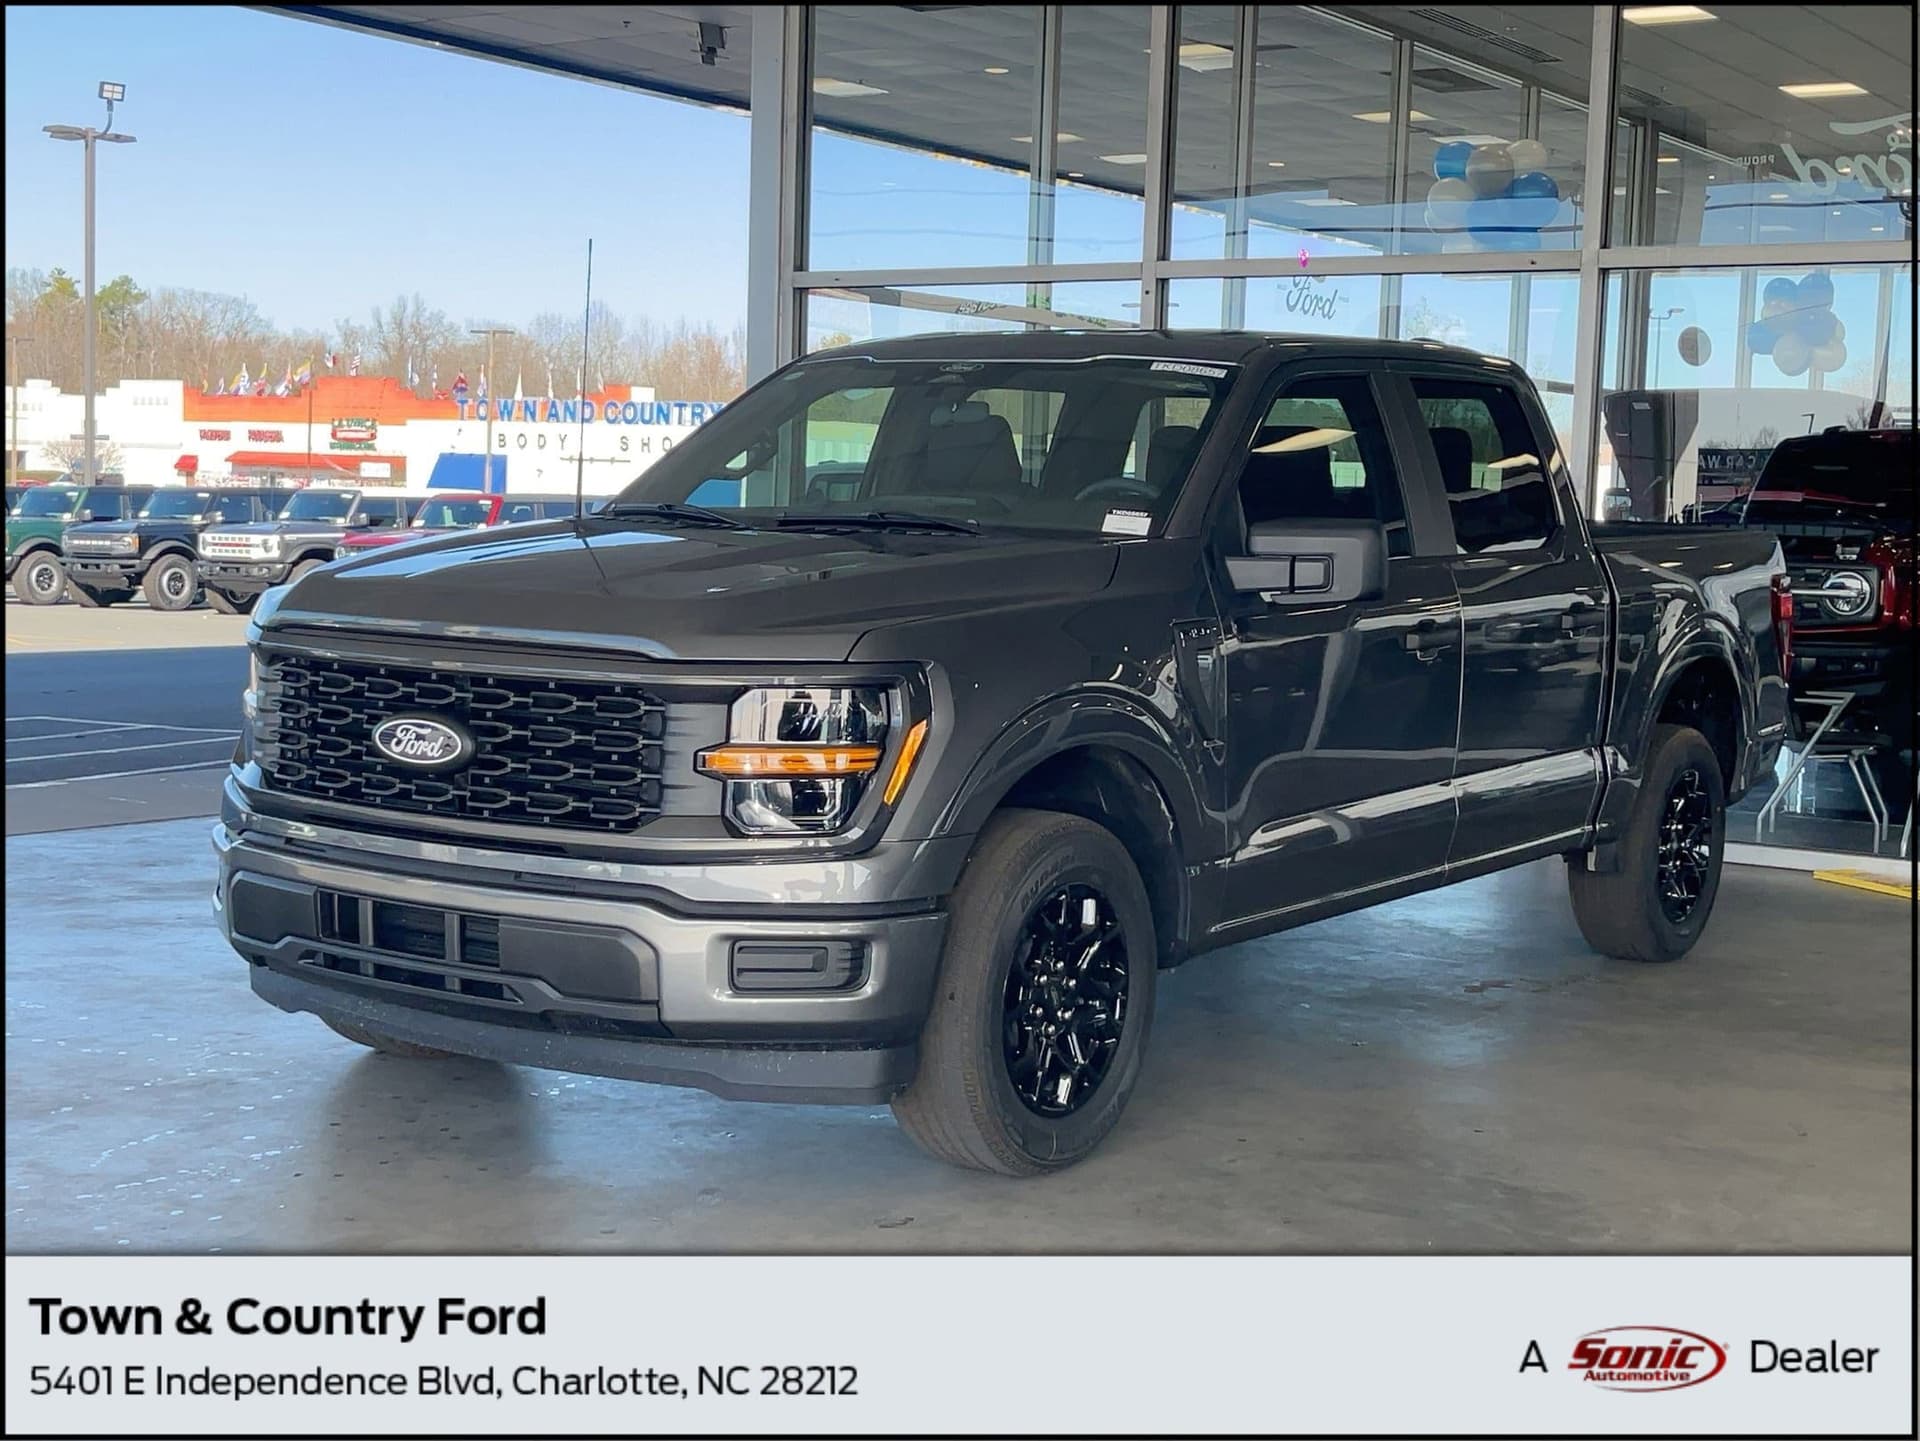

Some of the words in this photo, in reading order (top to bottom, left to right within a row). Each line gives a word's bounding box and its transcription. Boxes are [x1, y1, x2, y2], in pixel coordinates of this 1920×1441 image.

[1286, 276, 1338, 320] Ford
[457, 399, 538, 421] TOWN
[546, 399, 594, 423] AND
[605, 401, 722, 426] COUNTRY
[497, 433, 568, 449] BODY
[390, 724, 444, 758] Ford
